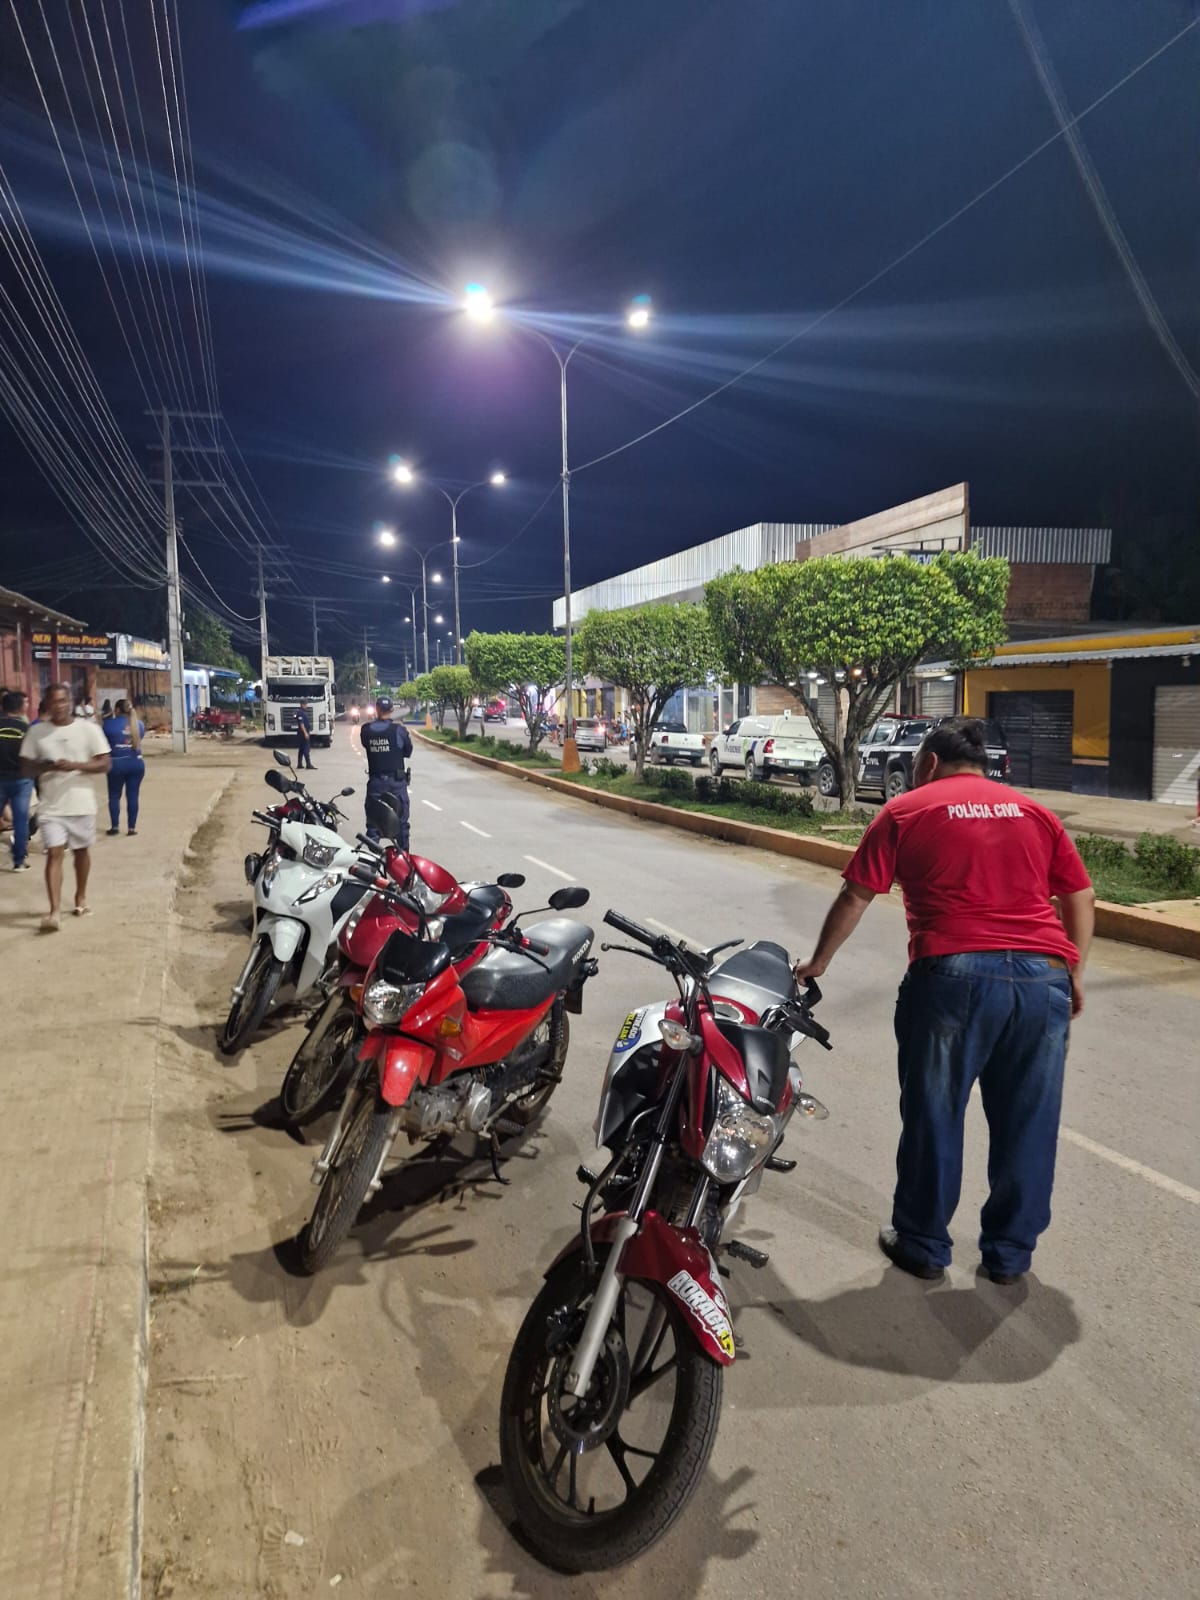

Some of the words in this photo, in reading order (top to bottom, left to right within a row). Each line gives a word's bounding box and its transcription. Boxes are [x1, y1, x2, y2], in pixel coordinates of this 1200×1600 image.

[370, 737, 389, 746] POLÍCIA
[947, 800, 993, 819] POLÍCIA
[993, 803, 1024, 817] CIVIL
[572, 938, 590, 965] HONDA
[756, 1095, 775, 1110] HONDA
